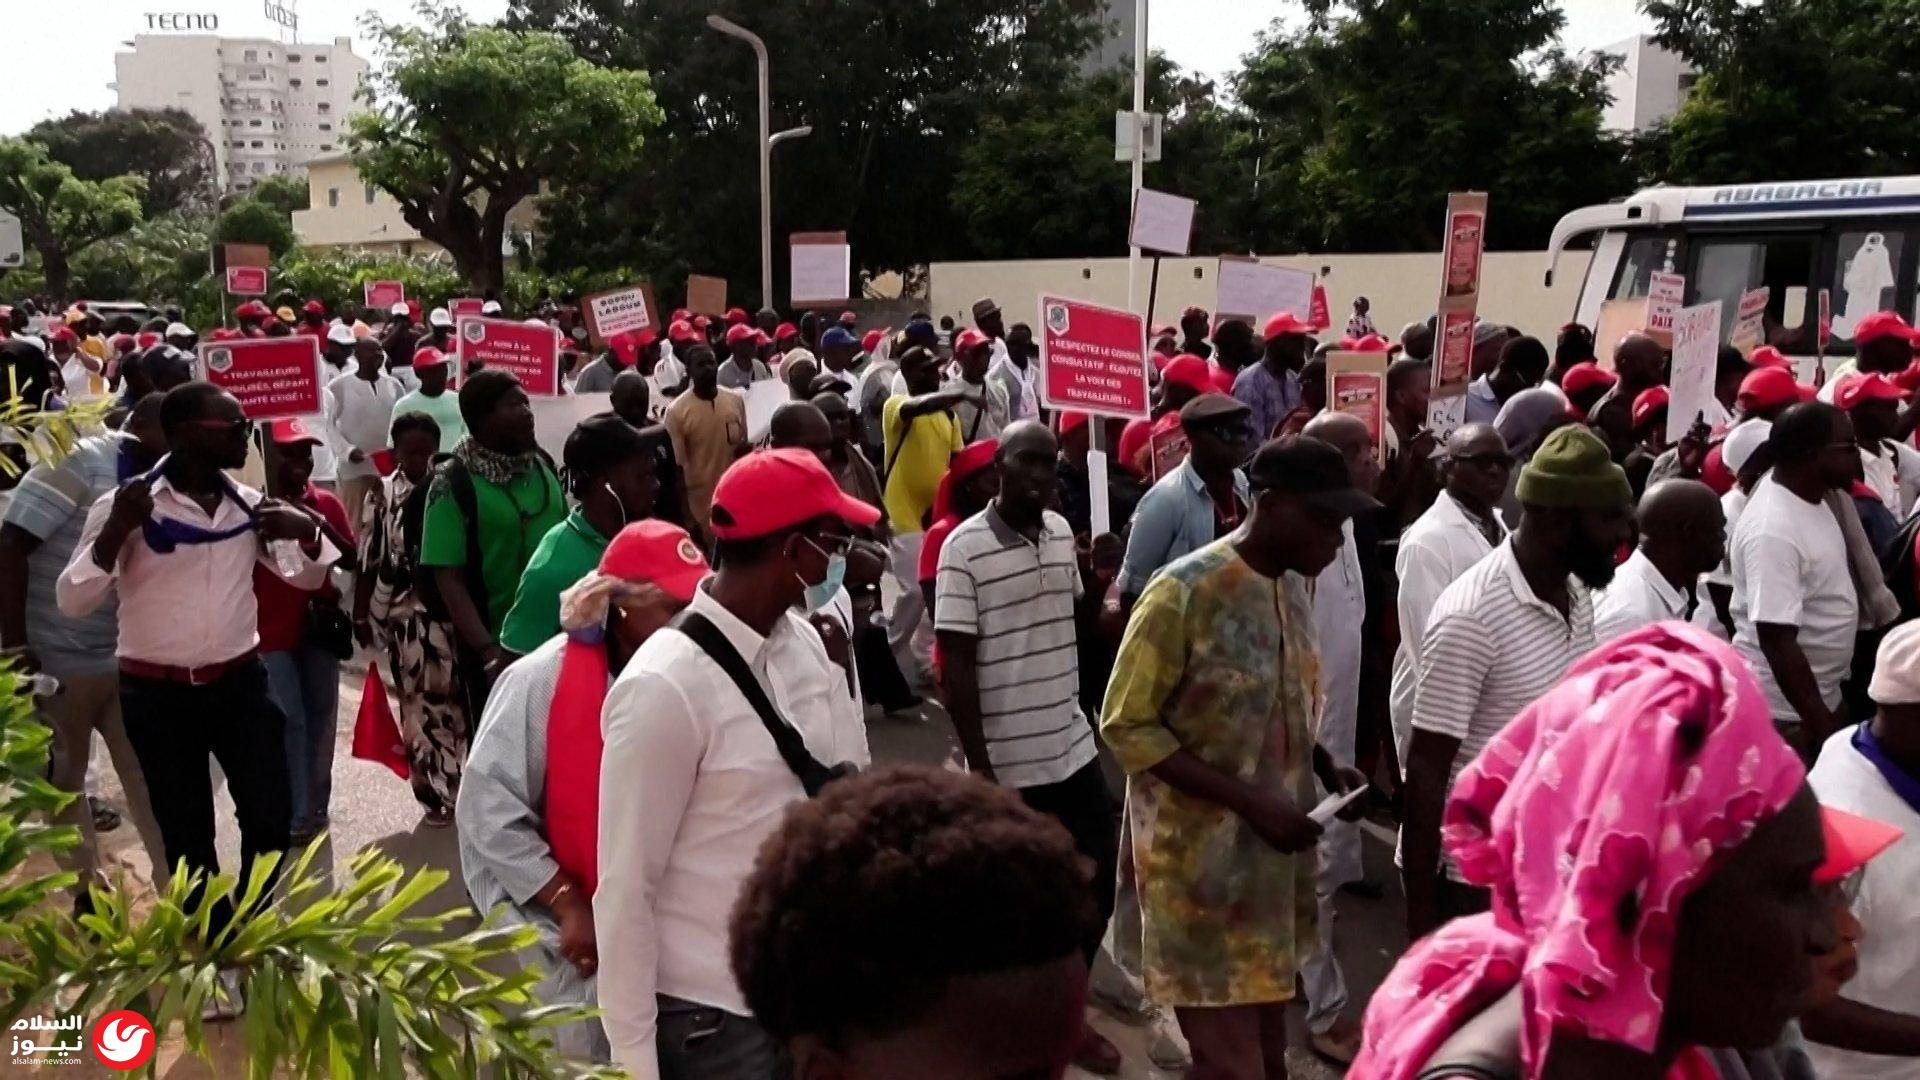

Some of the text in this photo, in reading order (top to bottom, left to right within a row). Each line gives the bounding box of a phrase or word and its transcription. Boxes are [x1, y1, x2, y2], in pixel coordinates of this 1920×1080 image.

[144, 12, 218, 30] TECNO
[230, 366, 301, 379] TRAVAILLEURS
[1087, 376, 1105, 387] VOIX
